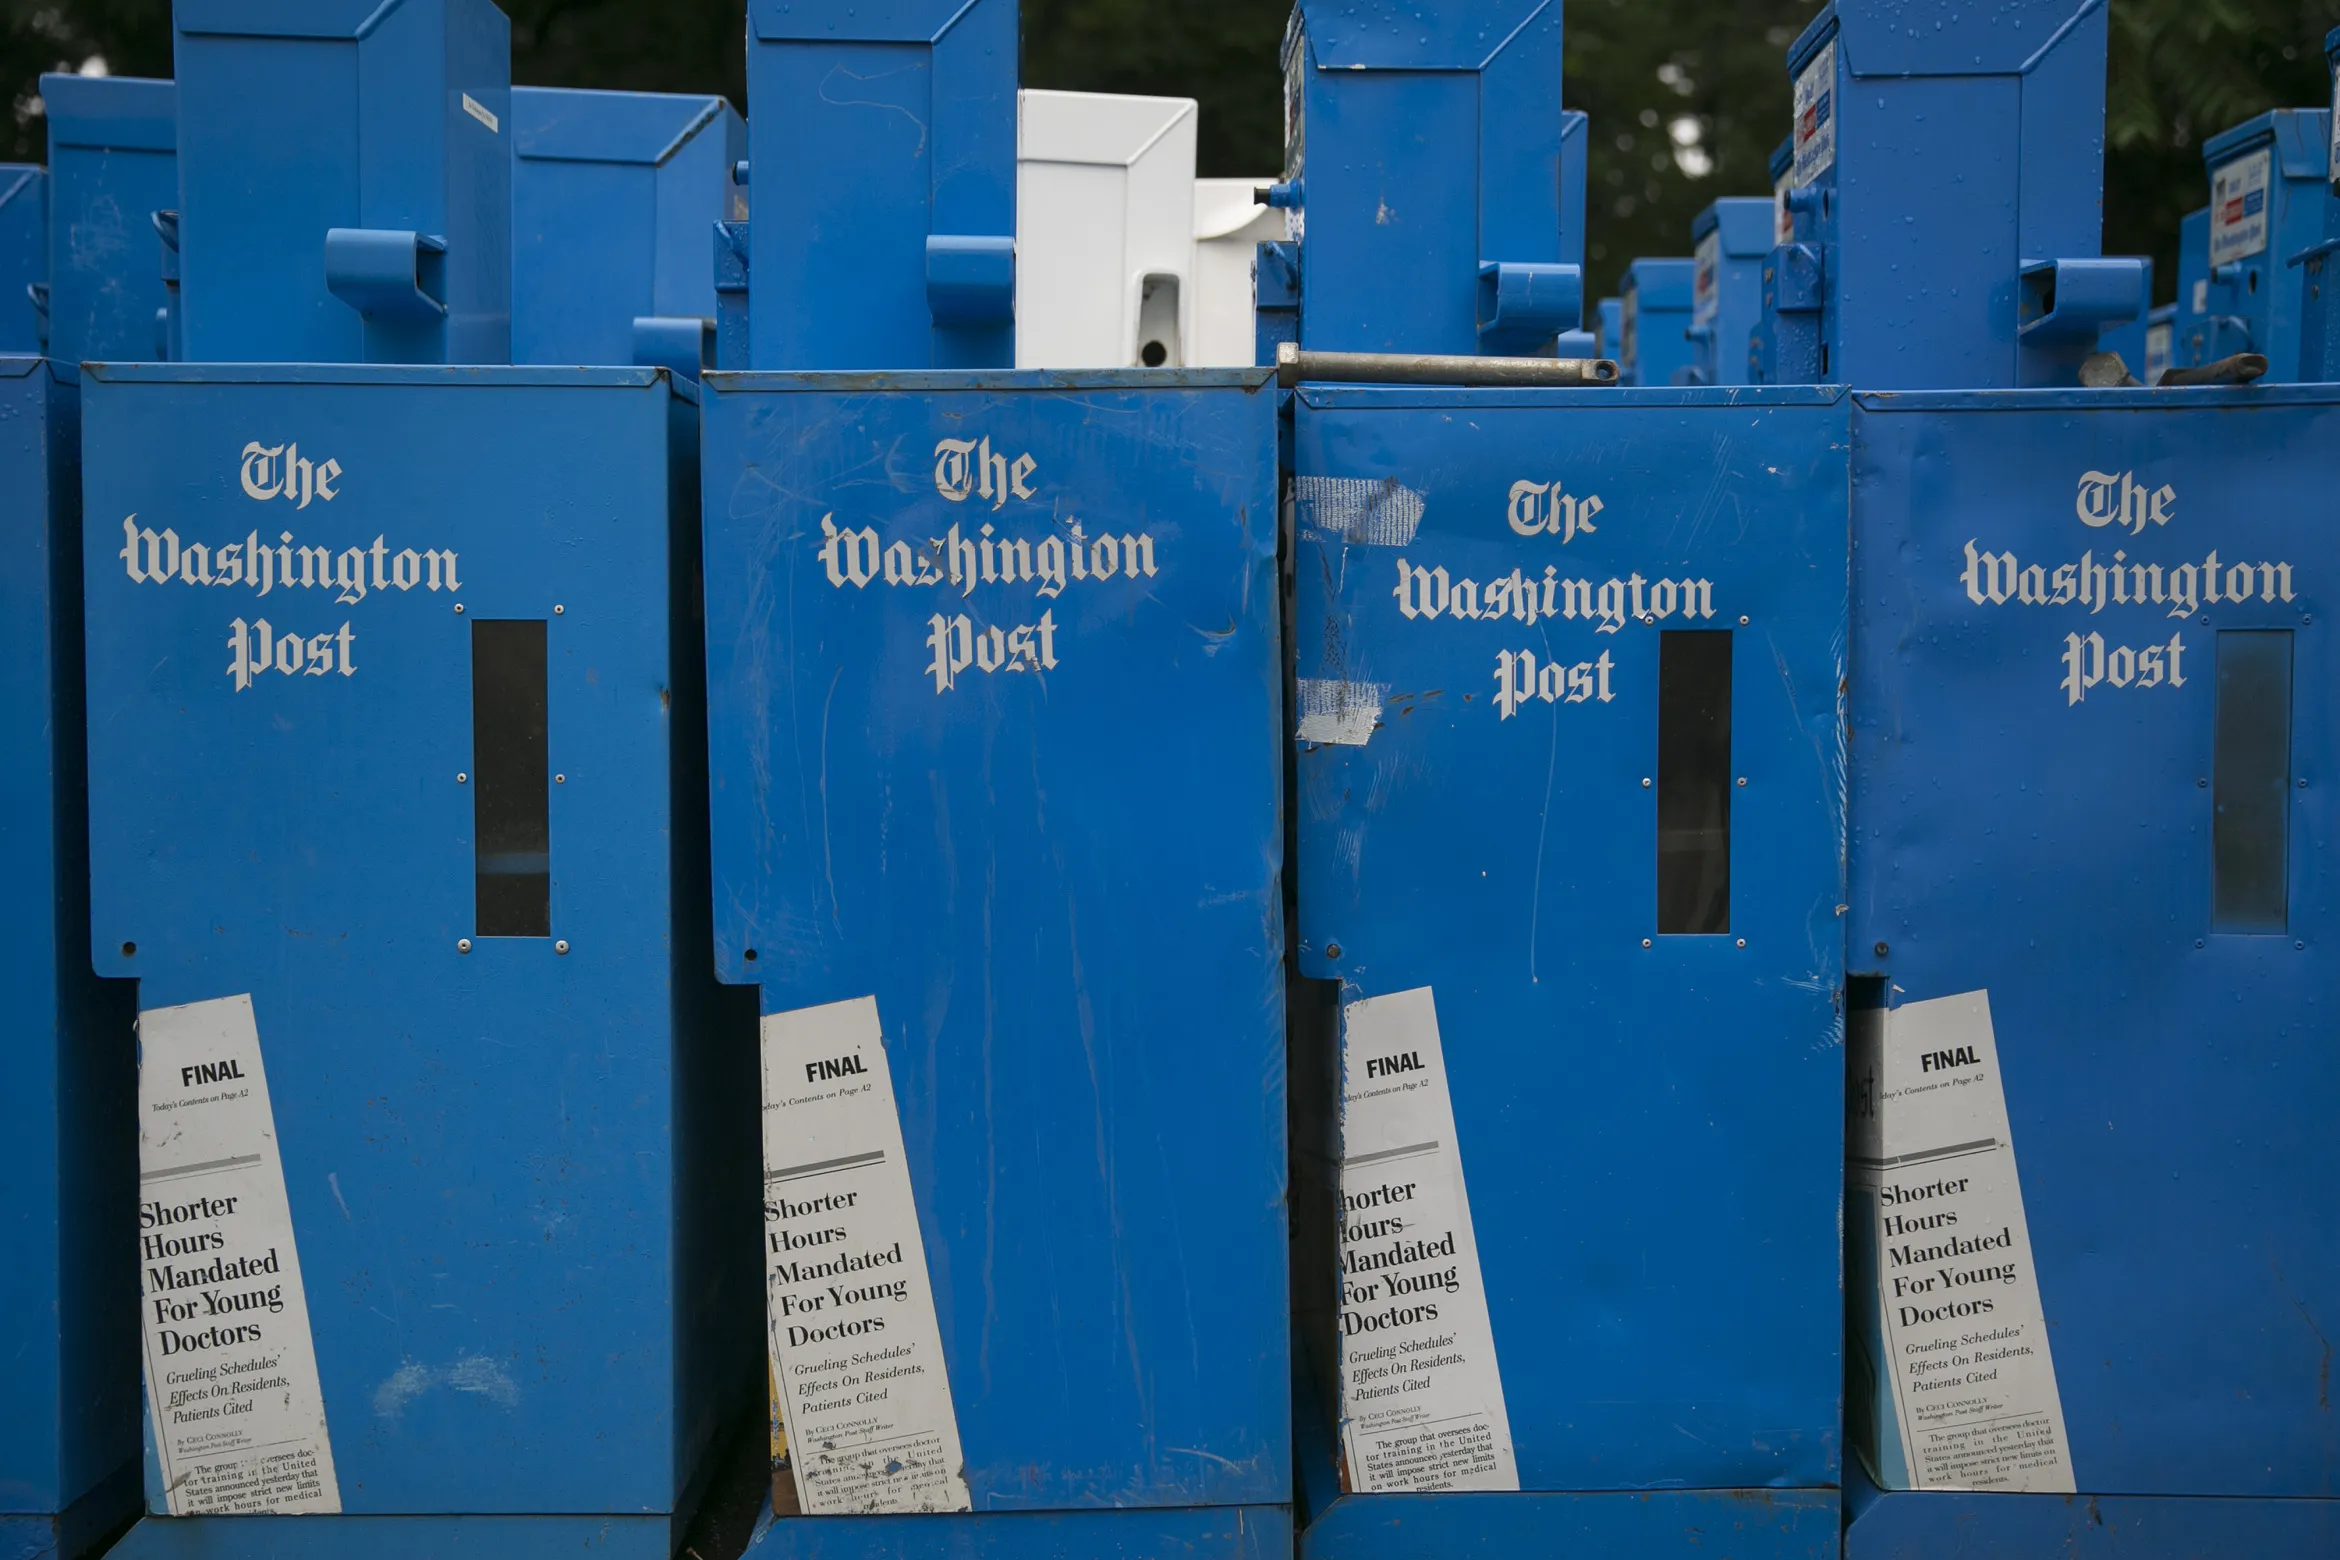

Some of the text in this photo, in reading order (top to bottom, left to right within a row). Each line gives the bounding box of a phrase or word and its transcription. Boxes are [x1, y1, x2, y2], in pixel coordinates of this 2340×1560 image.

[241, 442, 342, 509] The
[935, 436, 1036, 510] The
[1508, 480, 1603, 544] The
[2077, 471, 2176, 535] The
[120, 514, 461, 604] Washington
[818, 513, 1158, 598] Washington
[1960, 539, 2294, 618] Washington
[1393, 559, 1715, 633] Washington
[227, 618, 356, 692] Post
[925, 609, 1058, 694] Post
[1493, 649, 1615, 720] Post
[2061, 632, 2186, 706] Post
[181, 1059, 245, 1087] FINAL
[805, 1054, 868, 1083] FINAL
[1366, 1051, 1425, 1079] FINAL
[1920, 1045, 1981, 1073] FINAL
[788, 1094, 824, 1105] Contents
[839, 1088, 858, 1097] Page
[860, 1083, 871, 1092] A2
[1363, 1087, 1391, 1099] Contents
[1402, 1082, 1418, 1091] Page
[1419, 1078, 1429, 1087] A2
[1904, 1084, 1938, 1095] Contents
[1952, 1078, 1971, 1086] Page
[1973, 1073, 1984, 1081] A2
[151, 1100, 178, 1112] Today's
[178, 1096, 209, 1107] Contents
[220, 1092, 237, 1101] Page
[238, 1088, 249, 1098] A2
[763, 1192, 857, 1222] Shorter
[1340, 1183, 1416, 1214] horter
[1879, 1178, 1969, 1206] Shorter
[140, 1196, 237, 1229] Shorter
[1883, 1211, 1957, 1237] Hours
[143, 1232, 224, 1261] Hours
[768, 1227, 847, 1253] Hours
[1889, 1226, 2012, 1268] Mandated
[147, 1247, 280, 1293] Mandated
[773, 1242, 902, 1285] Mandated
[1340, 1265, 1459, 1306] For Young
[1893, 1263, 2016, 1297] For Young
[152, 1284, 284, 1324] For Young
[781, 1280, 907, 1316] For Young
[1899, 1298, 1994, 1327] Doctors
[787, 1317, 885, 1347] Doctors
[1342, 1303, 1438, 1336] Doctors
[157, 1324, 261, 1356] Doctors
[1349, 1332, 1456, 1364] Grueling Schedules'
[1905, 1324, 2024, 1355] Grueling Schedules'
[166, 1354, 280, 1384] Grueling Schedules'
[794, 1342, 915, 1375] Grueling Schedules'
[1352, 1353, 1465, 1385] Effects On Residents,
[1909, 1346, 2034, 1376] Effects On Residents,
[169, 1376, 290, 1407] Effects On Residents,
[798, 1364, 925, 1397] Effects On Residents,
[1355, 1375, 1430, 1401] Patients Cited
[1913, 1368, 1997, 1392] Patients Cited
[173, 1398, 253, 1424] Patients Cited
[802, 1387, 887, 1414] Patients Cited
[1365, 1453, 1379, 1462] tor
[1383, 1445, 1422, 1459] training
[1425, 1442, 1436, 1451] in
[1458, 1431, 1492, 1445] United
[1375, 1423, 1489, 1449] The group that oversees doc-
[1367, 1461, 1394, 1472] States
[1476, 1442, 1493, 1452] that
[1369, 1452, 1495, 1481] it will impose strict new limits
[185, 1469, 318, 1497] States announced yesterday that
[187, 1479, 320, 1507] it will impose strict new limits
[1370, 1483, 1382, 1491] on
[1386, 1477, 1409, 1488] work
[1412, 1473, 1439, 1484] hours
[1443, 1470, 1456, 1478] for
